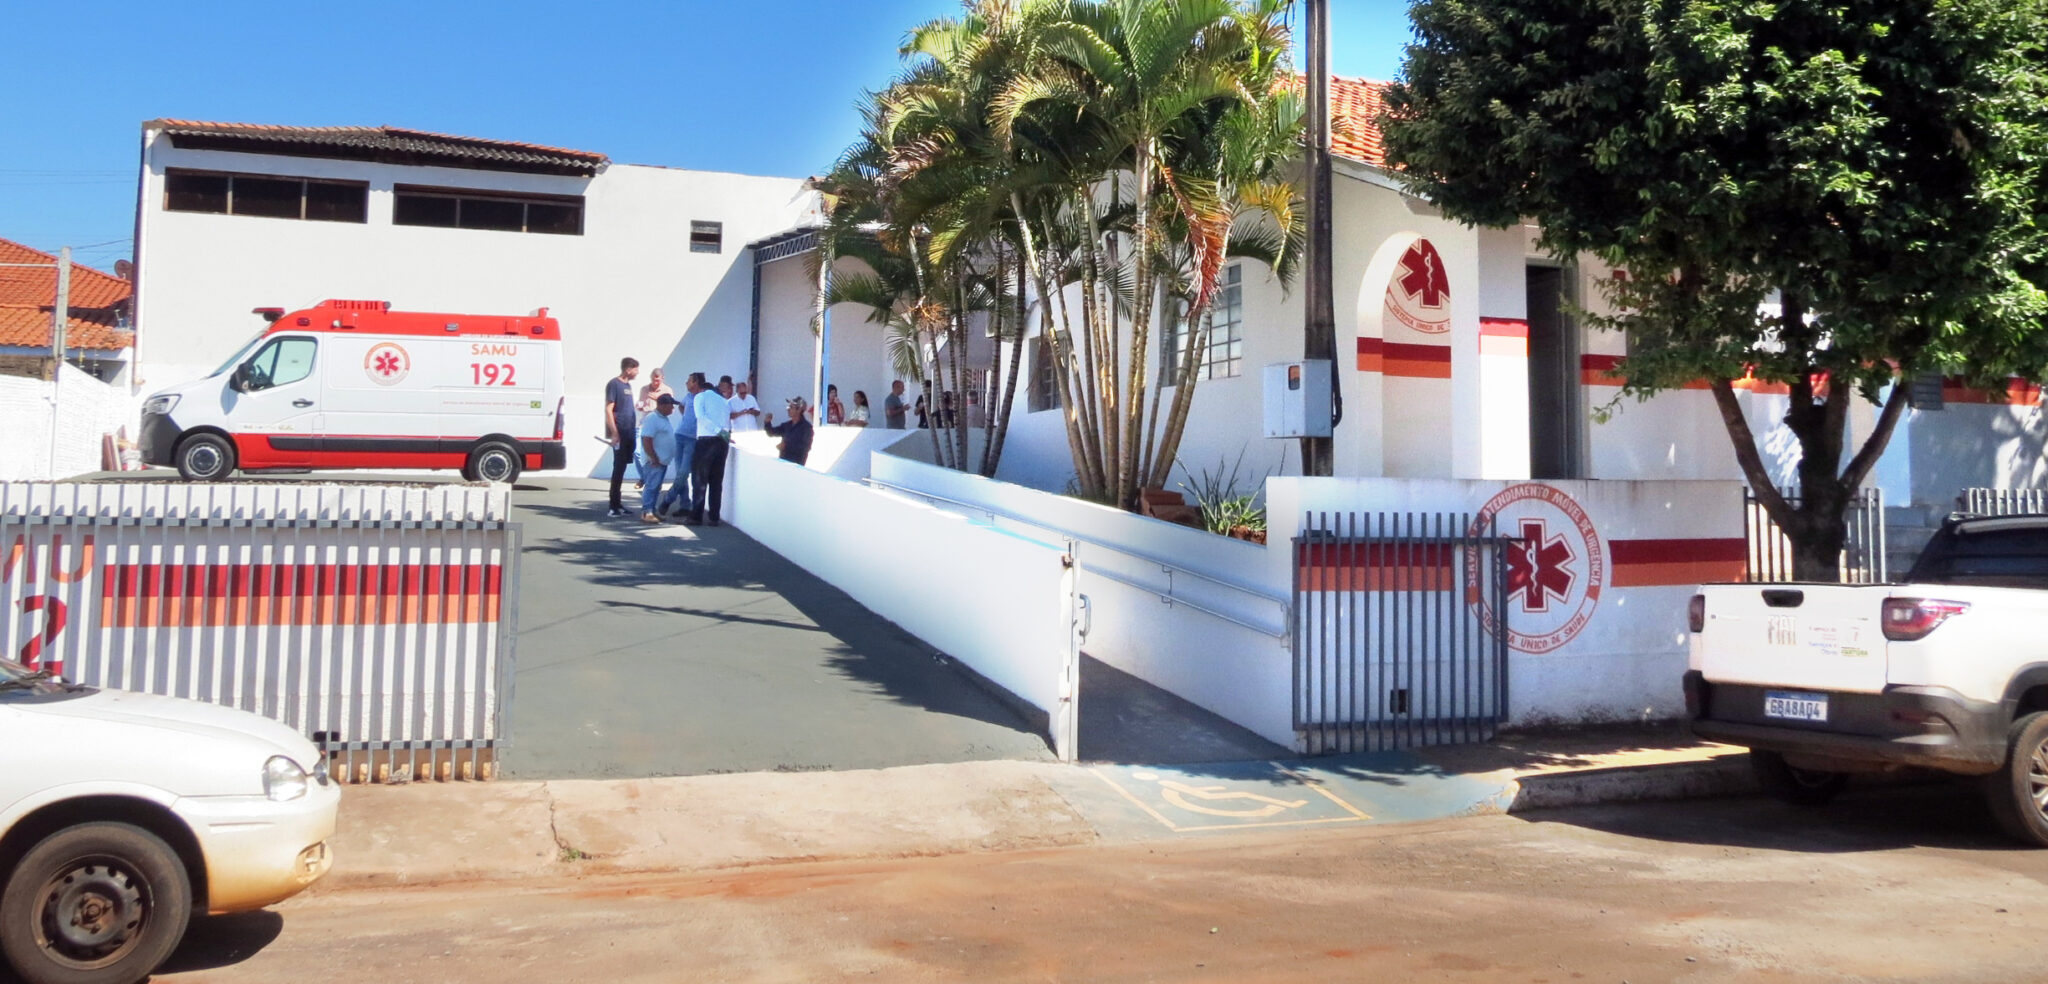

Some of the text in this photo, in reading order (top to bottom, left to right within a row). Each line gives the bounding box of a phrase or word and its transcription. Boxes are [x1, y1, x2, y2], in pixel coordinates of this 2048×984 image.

[471, 343, 517, 356] SAMU
[470, 362, 517, 386] 192
[1579, 519, 1592, 534] DE
[1767, 615, 1797, 645] FIAT
[1770, 699, 1820, 718] GBA8A04
